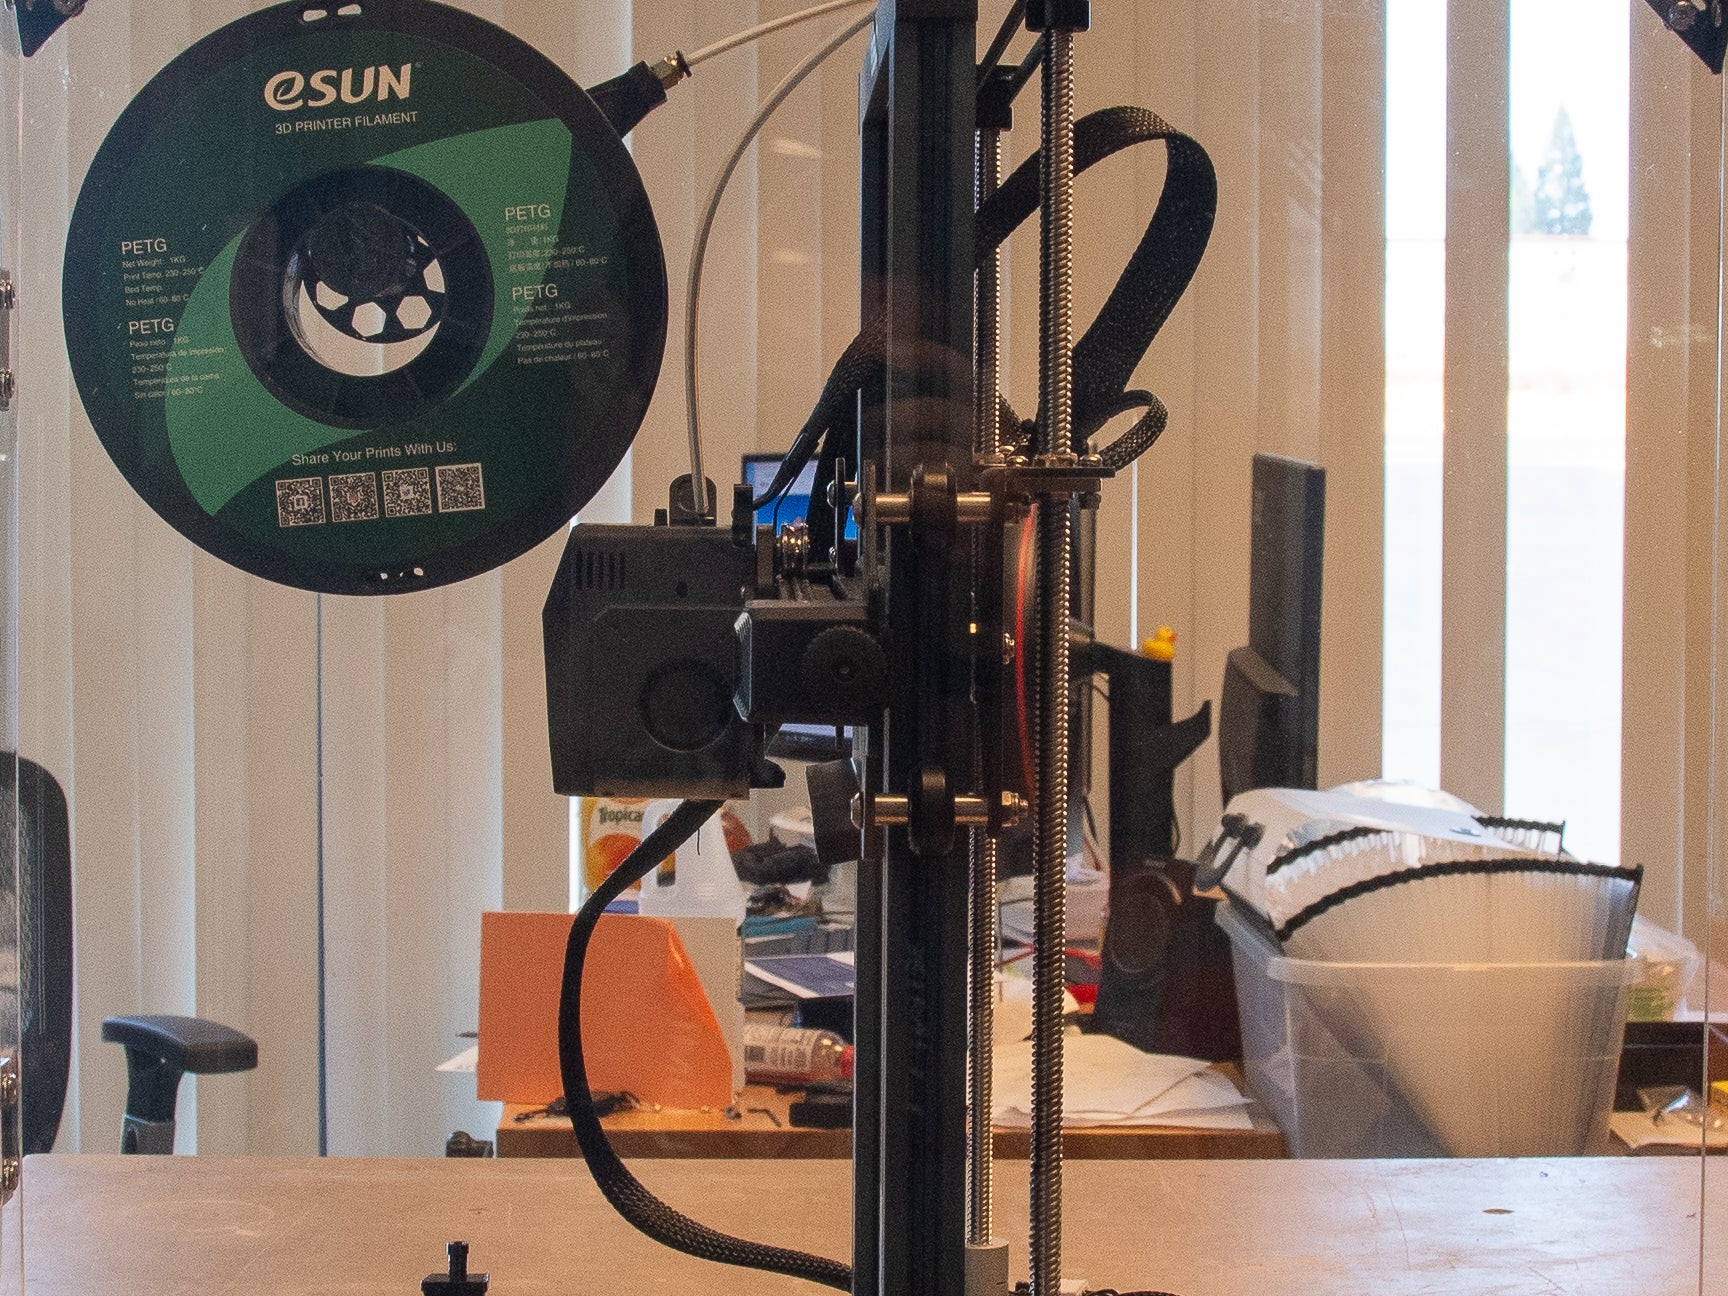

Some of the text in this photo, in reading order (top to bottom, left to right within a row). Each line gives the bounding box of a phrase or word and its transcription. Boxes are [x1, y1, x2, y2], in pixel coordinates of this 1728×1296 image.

[275, 111, 418, 134] 3D PRINTER FILAMENT
[504, 203, 551, 221] PETG
[121, 238, 167, 255] PETG
[170, 256, 186, 264] 1KG
[511, 283, 558, 301] PETG
[128, 317, 174, 335] PETG
[291, 440, 457, 466] Share Your Prints With Us:
[598, 805, 644, 826] Tropica
